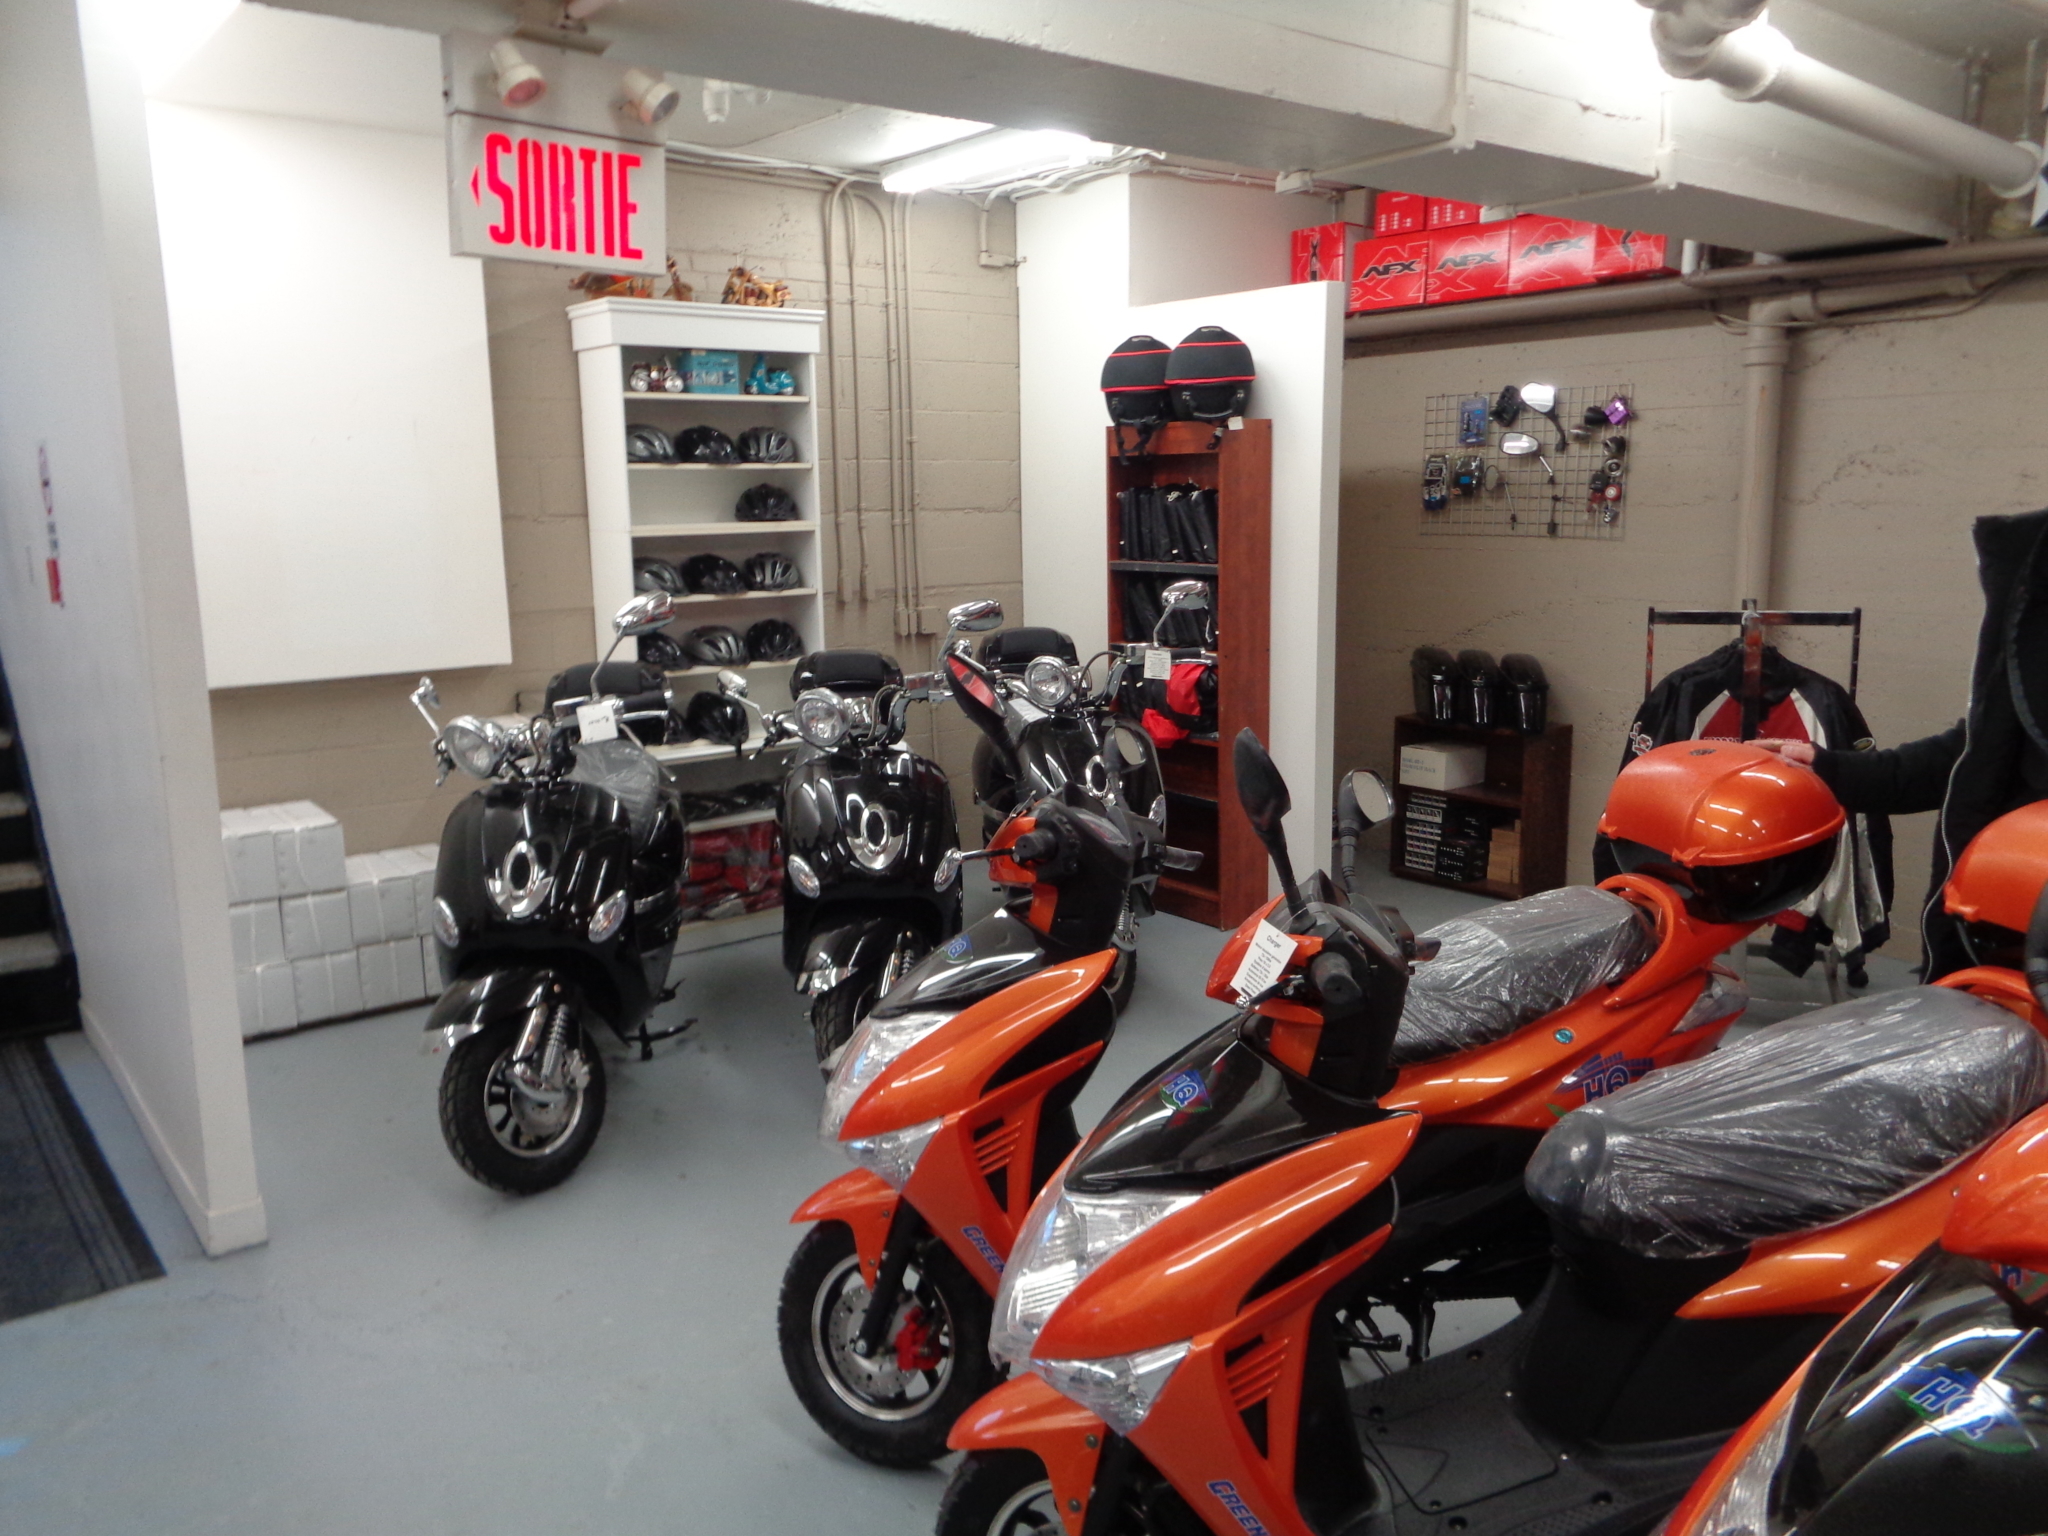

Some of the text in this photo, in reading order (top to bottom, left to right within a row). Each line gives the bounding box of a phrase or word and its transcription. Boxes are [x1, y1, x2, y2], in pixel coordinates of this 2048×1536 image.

[485, 132, 643, 260] SORTIE
[1519, 236, 1587, 259] AFX
[1360, 259, 1421, 280] AFX
[1435, 250, 1498, 271] AFX
